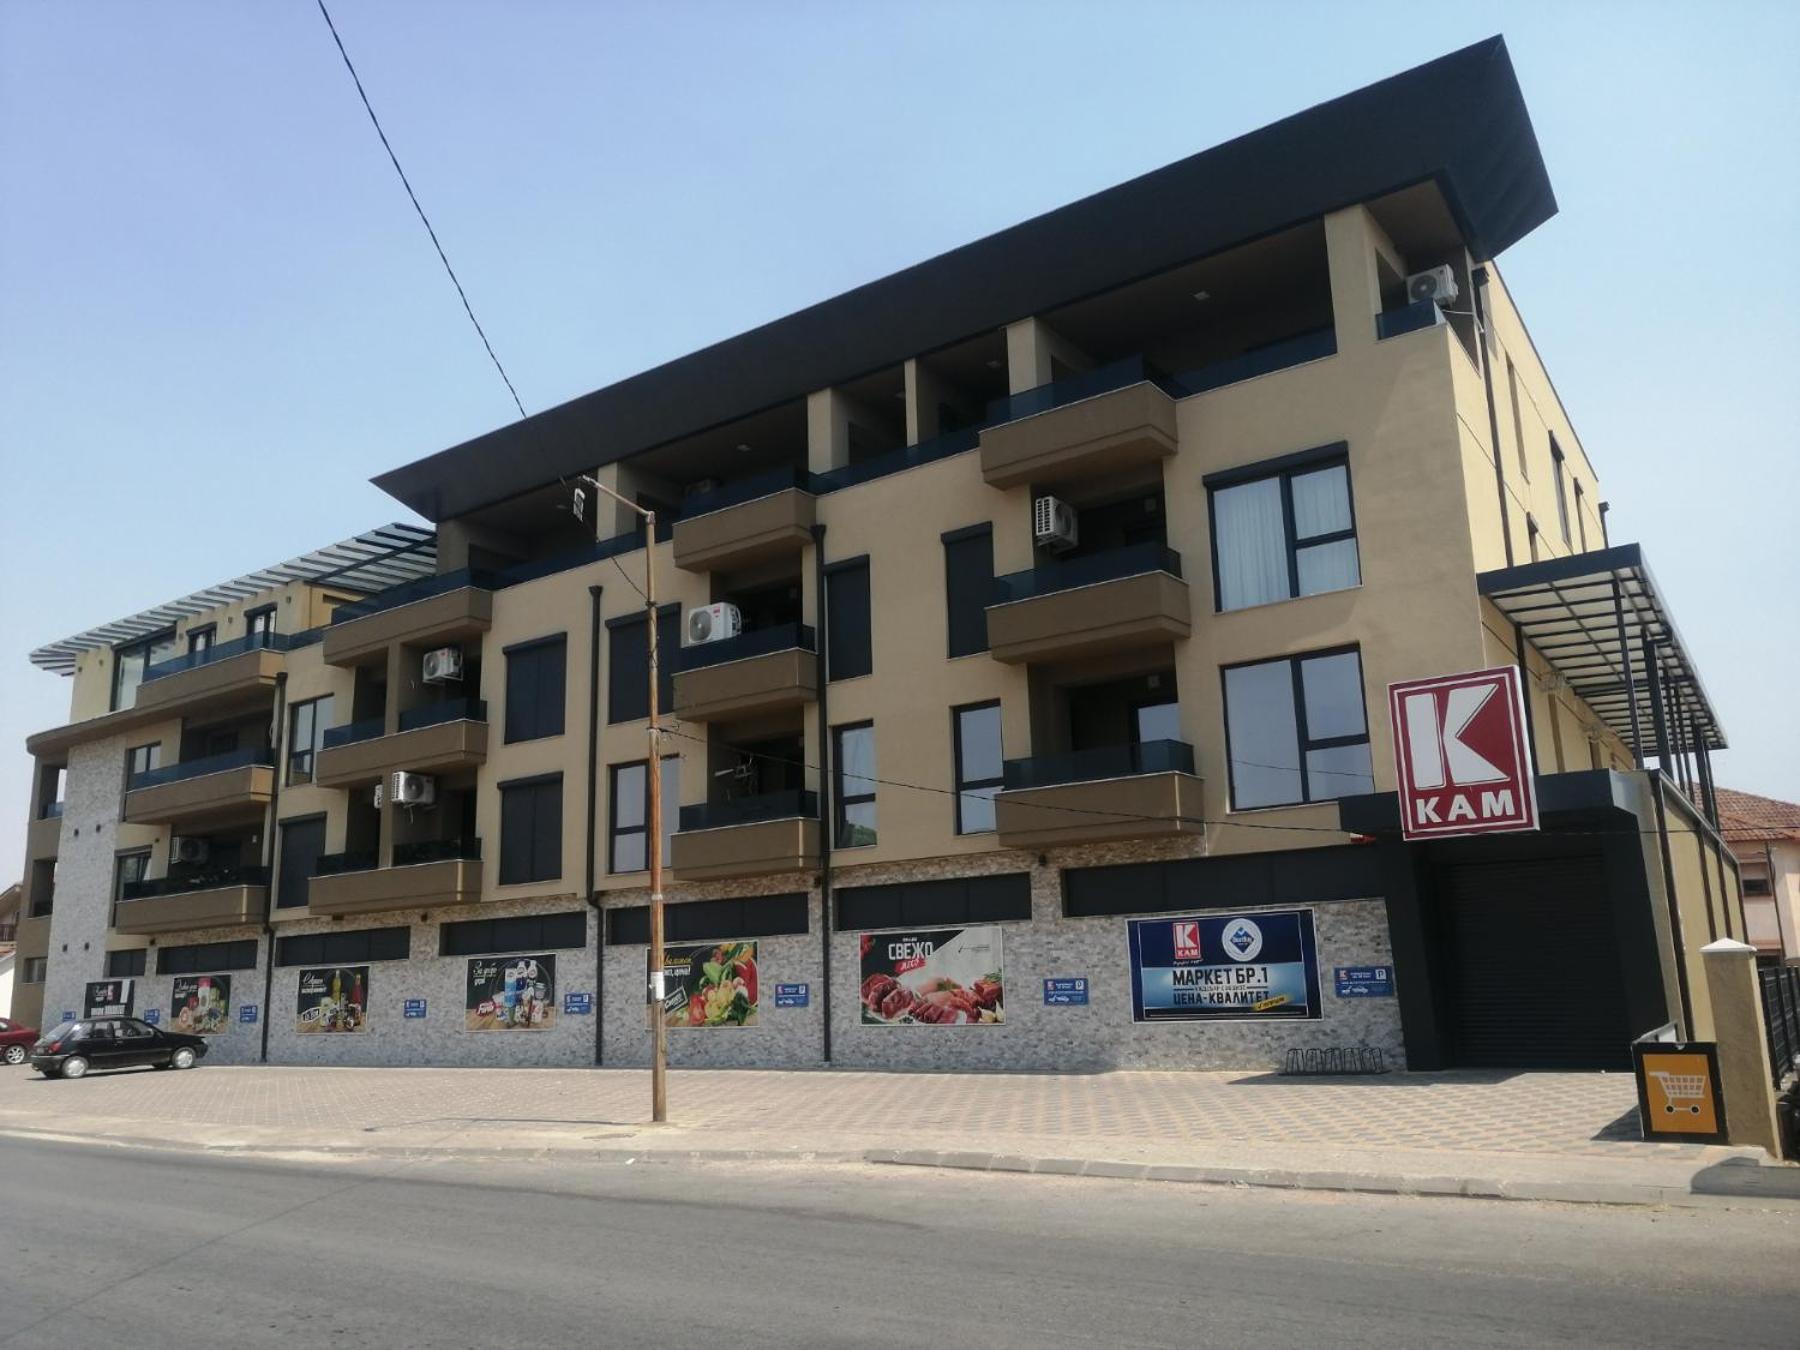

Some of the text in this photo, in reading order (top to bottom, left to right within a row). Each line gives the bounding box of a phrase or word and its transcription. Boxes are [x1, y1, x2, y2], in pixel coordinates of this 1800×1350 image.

[888, 941, 935, 960] СВЕЖО
[1172, 966, 1269, 986] МАРКЕТ БР.1
[1173, 990, 1270, 1005] ЦЕНА-КВАЛИТЕТ
